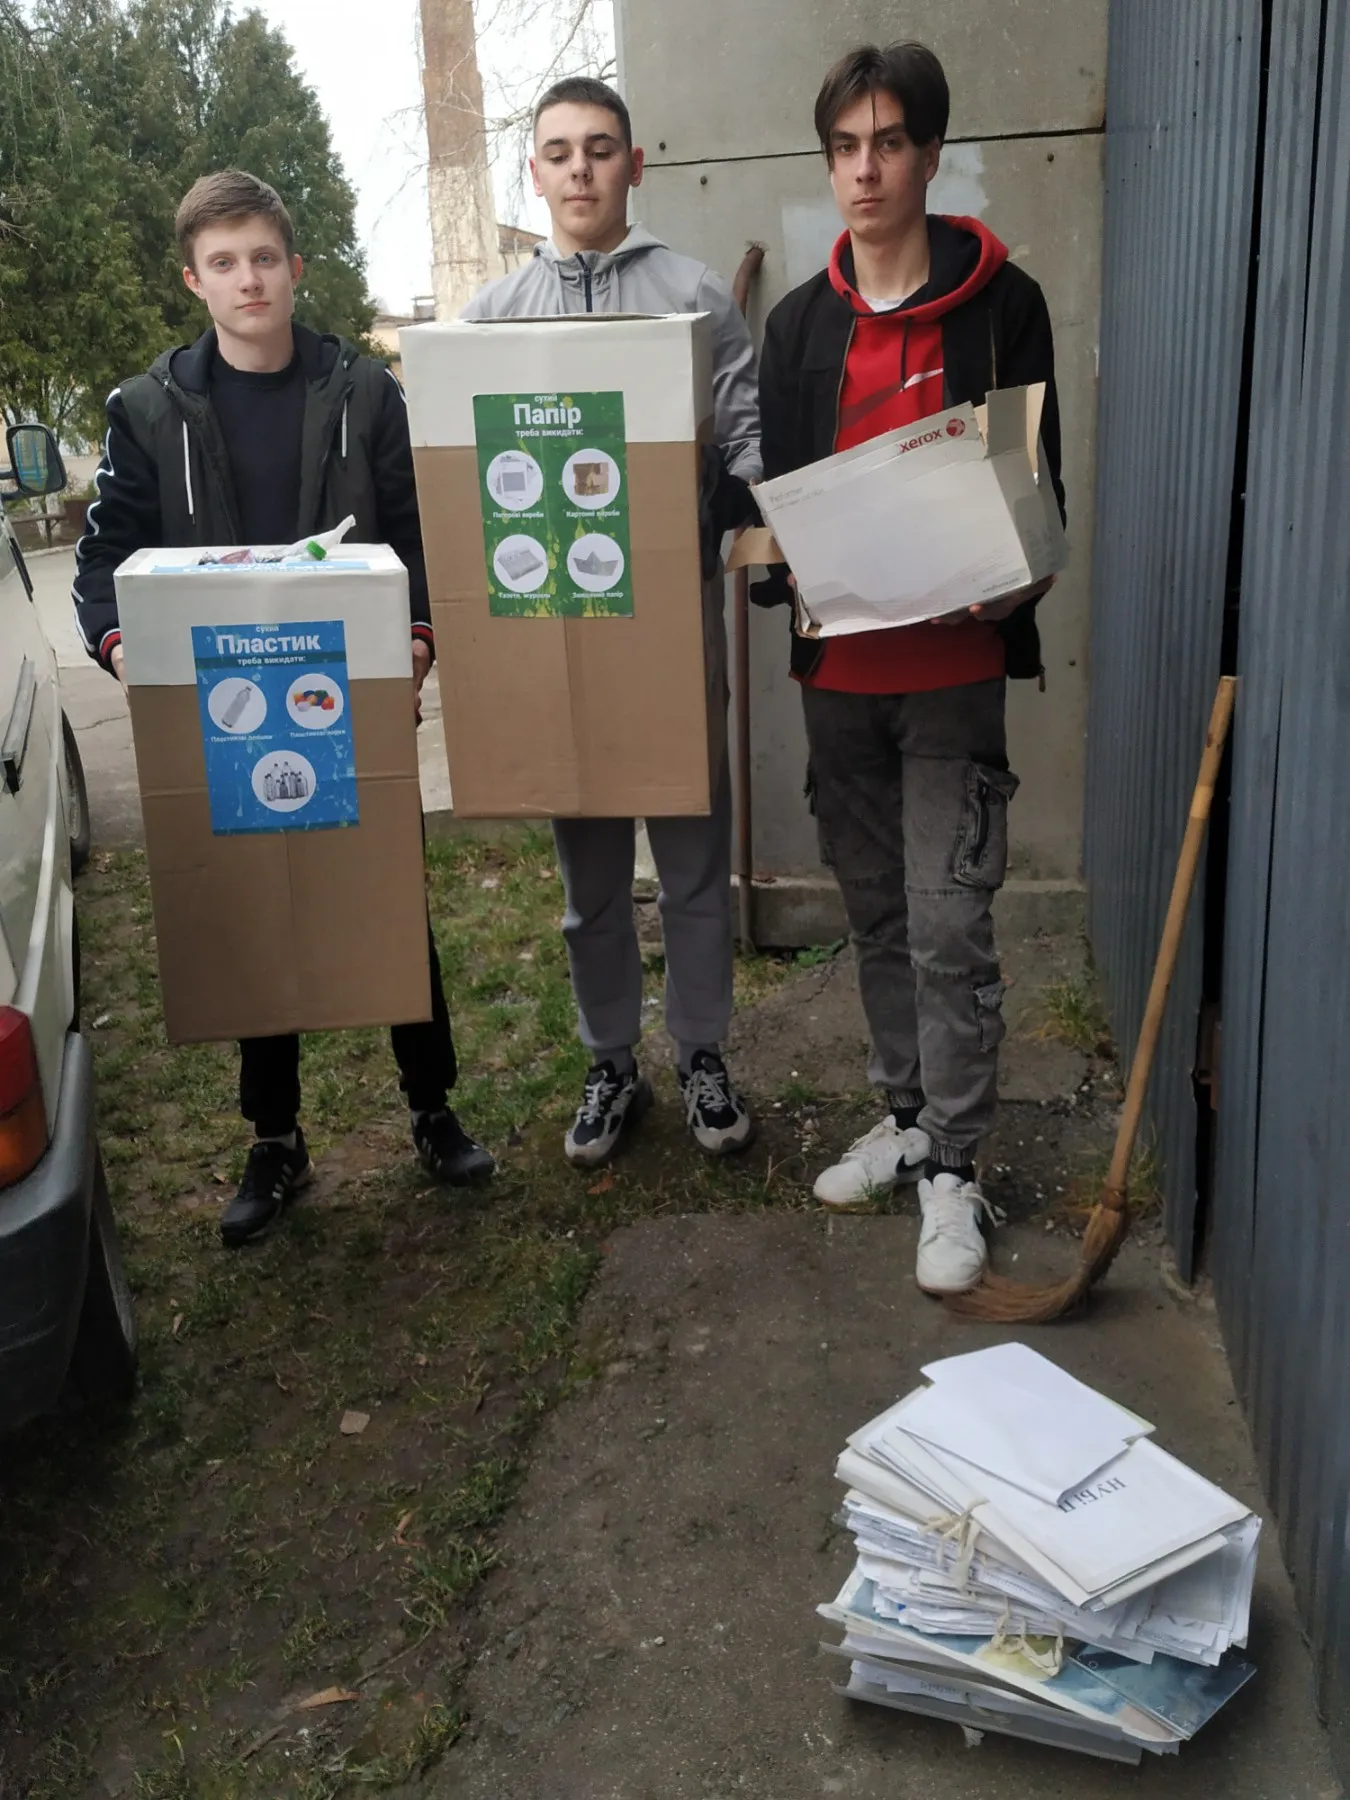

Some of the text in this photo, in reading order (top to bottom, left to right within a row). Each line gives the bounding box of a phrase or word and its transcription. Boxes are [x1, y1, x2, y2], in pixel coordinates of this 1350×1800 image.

[513, 402, 581, 428] Папір
[516, 428, 584, 438] треба викидати:
[900, 429, 942, 453] xerox
[216, 634, 321, 655] Пластик
[237, 655, 306, 667] треба викидати:
